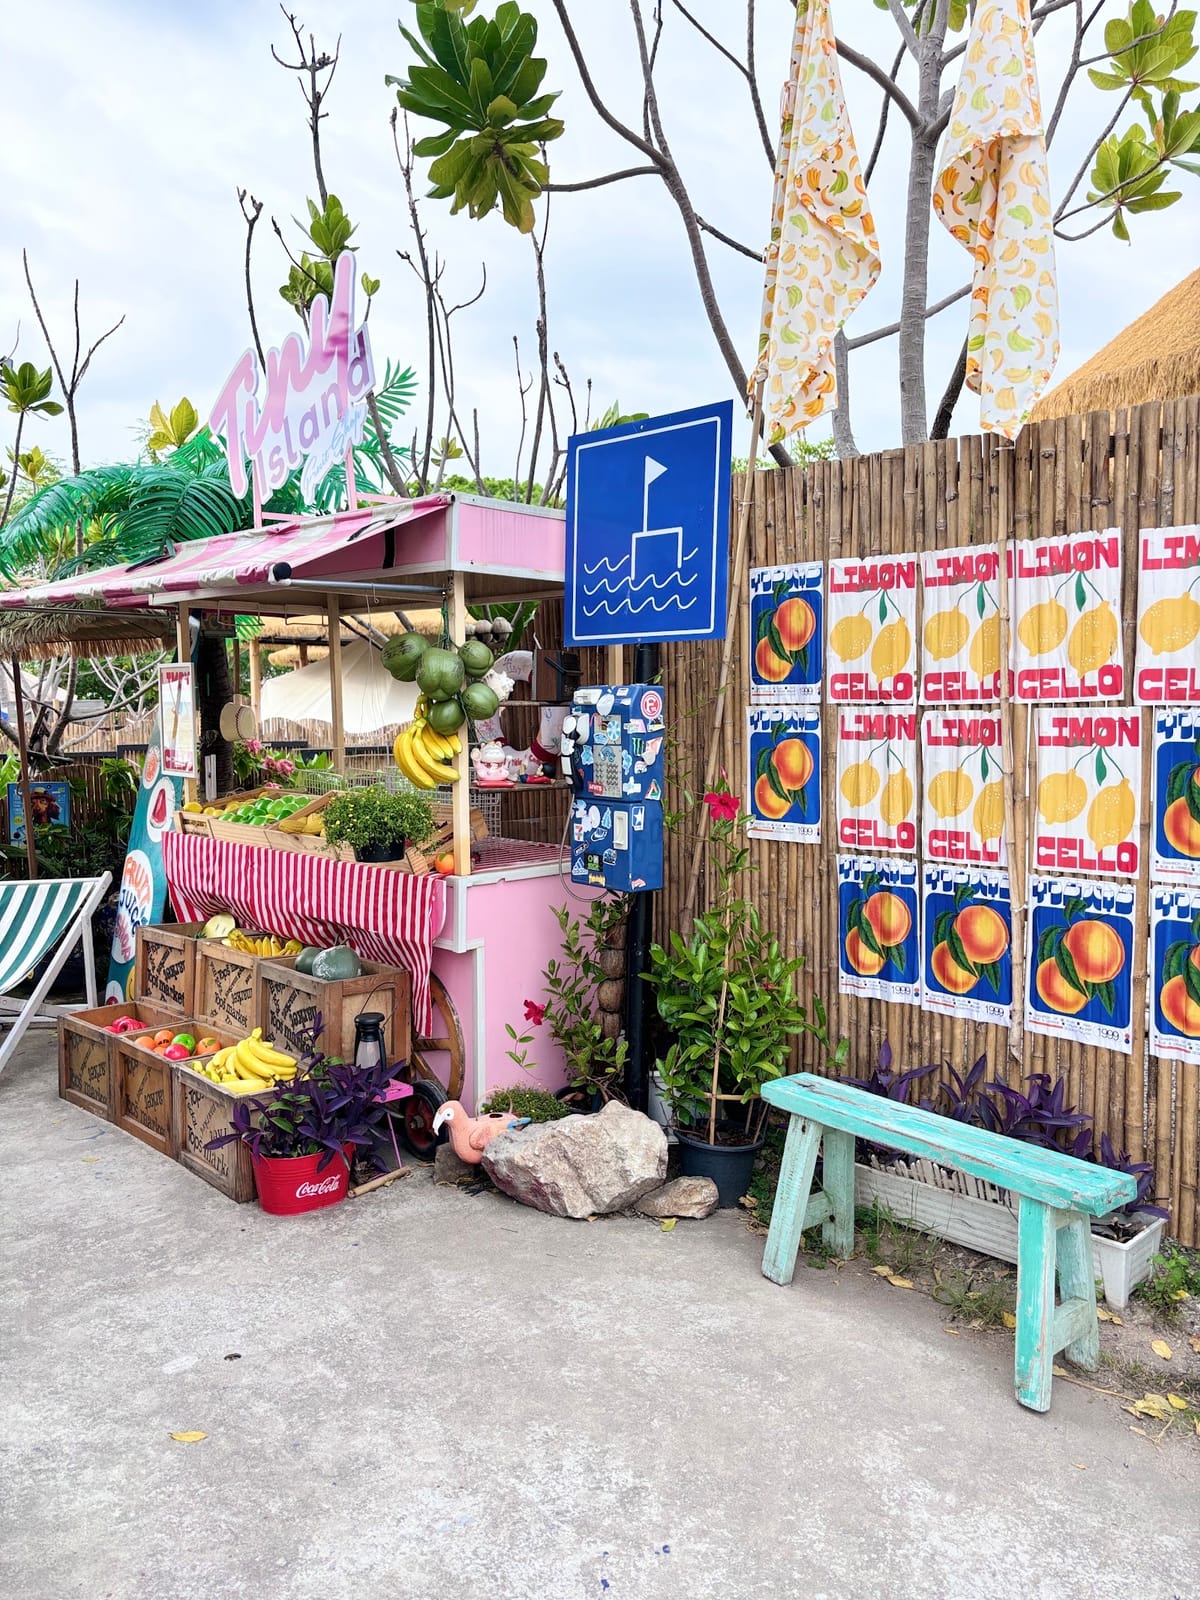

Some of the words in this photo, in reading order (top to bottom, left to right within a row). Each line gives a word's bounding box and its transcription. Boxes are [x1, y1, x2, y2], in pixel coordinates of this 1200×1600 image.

[261, 330, 369, 497] Island
[1018, 538, 1119, 578] LIMON
[831, 561, 917, 592] LIMON
[831, 673, 914, 701] CELLO
[1018, 665, 1124, 699] CELLO
[841, 714, 917, 741] LIMON
[927, 719, 1002, 746] LIMO
[1038, 716, 1140, 746] LIMON
[929, 829, 1002, 863] CELL
[1037, 837, 1138, 873] CELLO
[891, 985, 911, 995] 1999
[985, 1005, 1005, 1018] 1999
